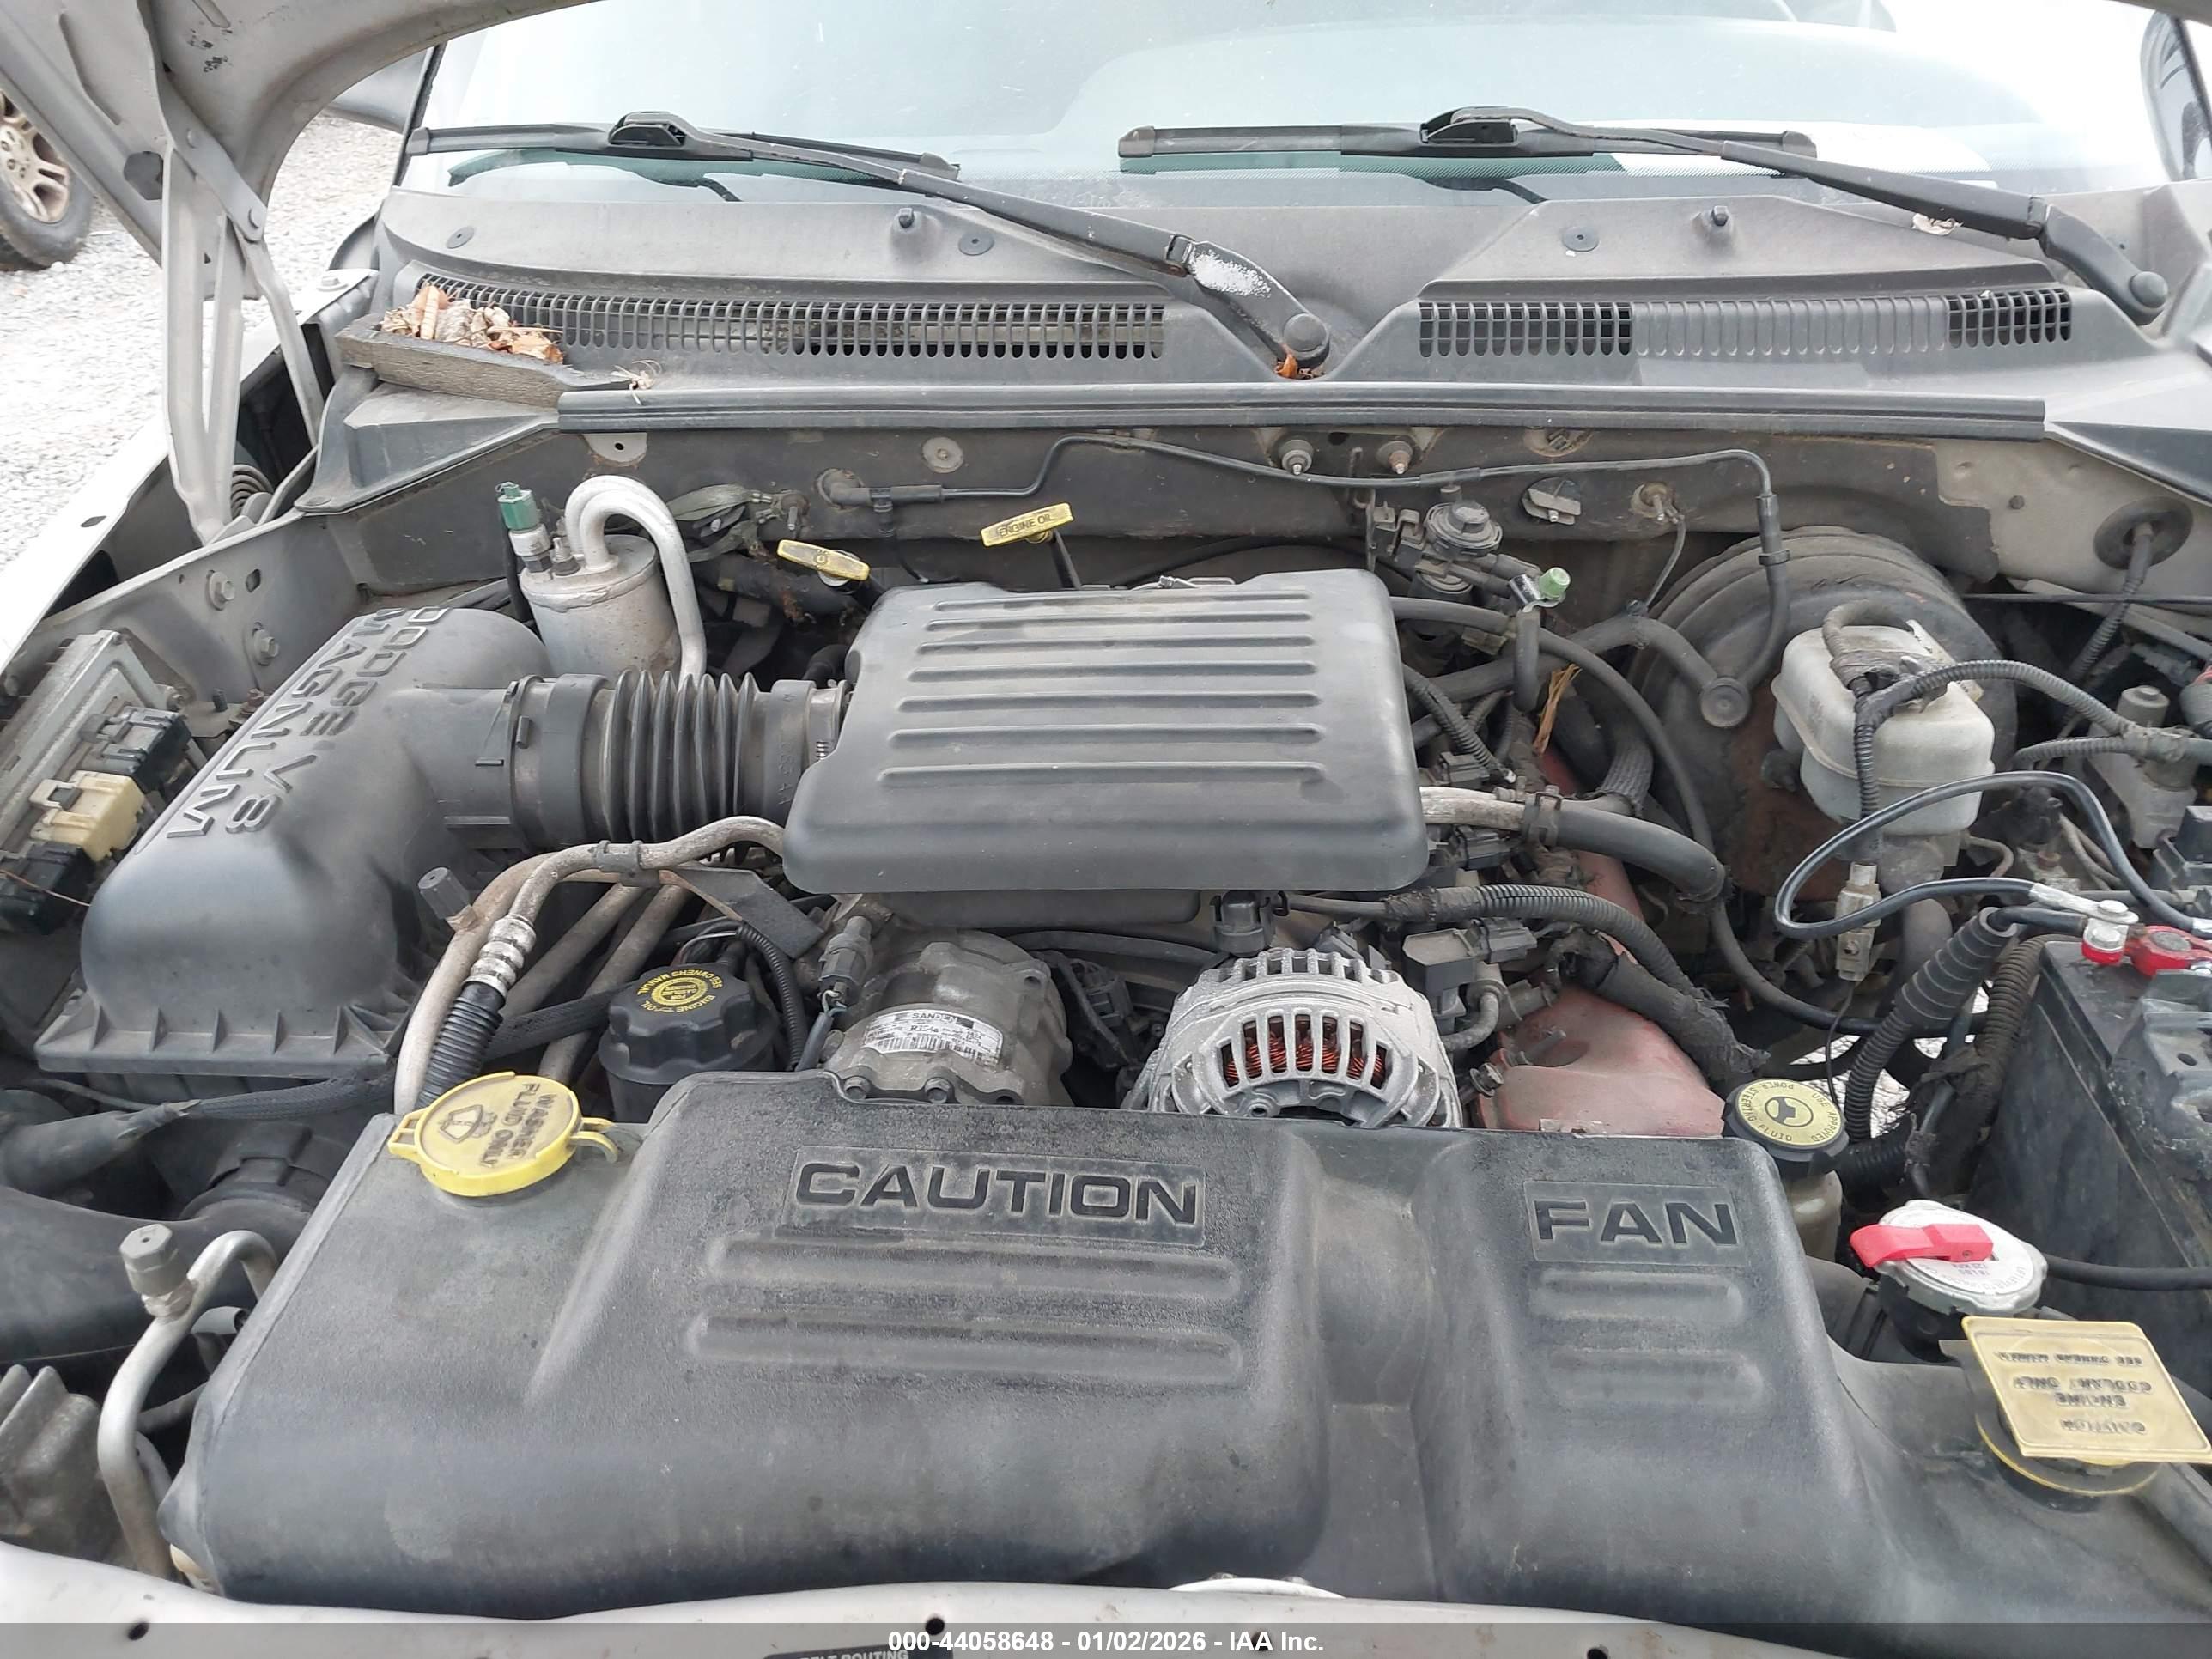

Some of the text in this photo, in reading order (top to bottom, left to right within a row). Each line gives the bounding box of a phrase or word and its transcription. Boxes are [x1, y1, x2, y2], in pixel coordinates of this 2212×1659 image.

[999, 514, 1055, 537] ENGINE OIL
[167, 608, 407, 839] MAGNUM
[225, 606, 452, 835] DODGE V8
[637, 974, 670, 996] MANUAL
[709, 975, 723, 989] SEE
[676, 994, 716, 1013] ENGINE
[480, 1083, 542, 1168] FLUID ONLY
[508, 1094, 557, 1158] WASHER
[1741, 1081, 1794, 1142] POWER STEERING FLUID
[1811, 1093, 1838, 1142] USE APPROVED
[795, 1164, 1199, 1224] CAUTION
[1535, 1198, 1739, 1245] FAN
[2115, 1354, 2143, 1365] SEE
[2014, 1376, 2153, 1392] COOLANT ONLY
[2054, 1391, 2127, 1407] ENGINE
[2061, 1418, 2147, 1435] CAUTION
